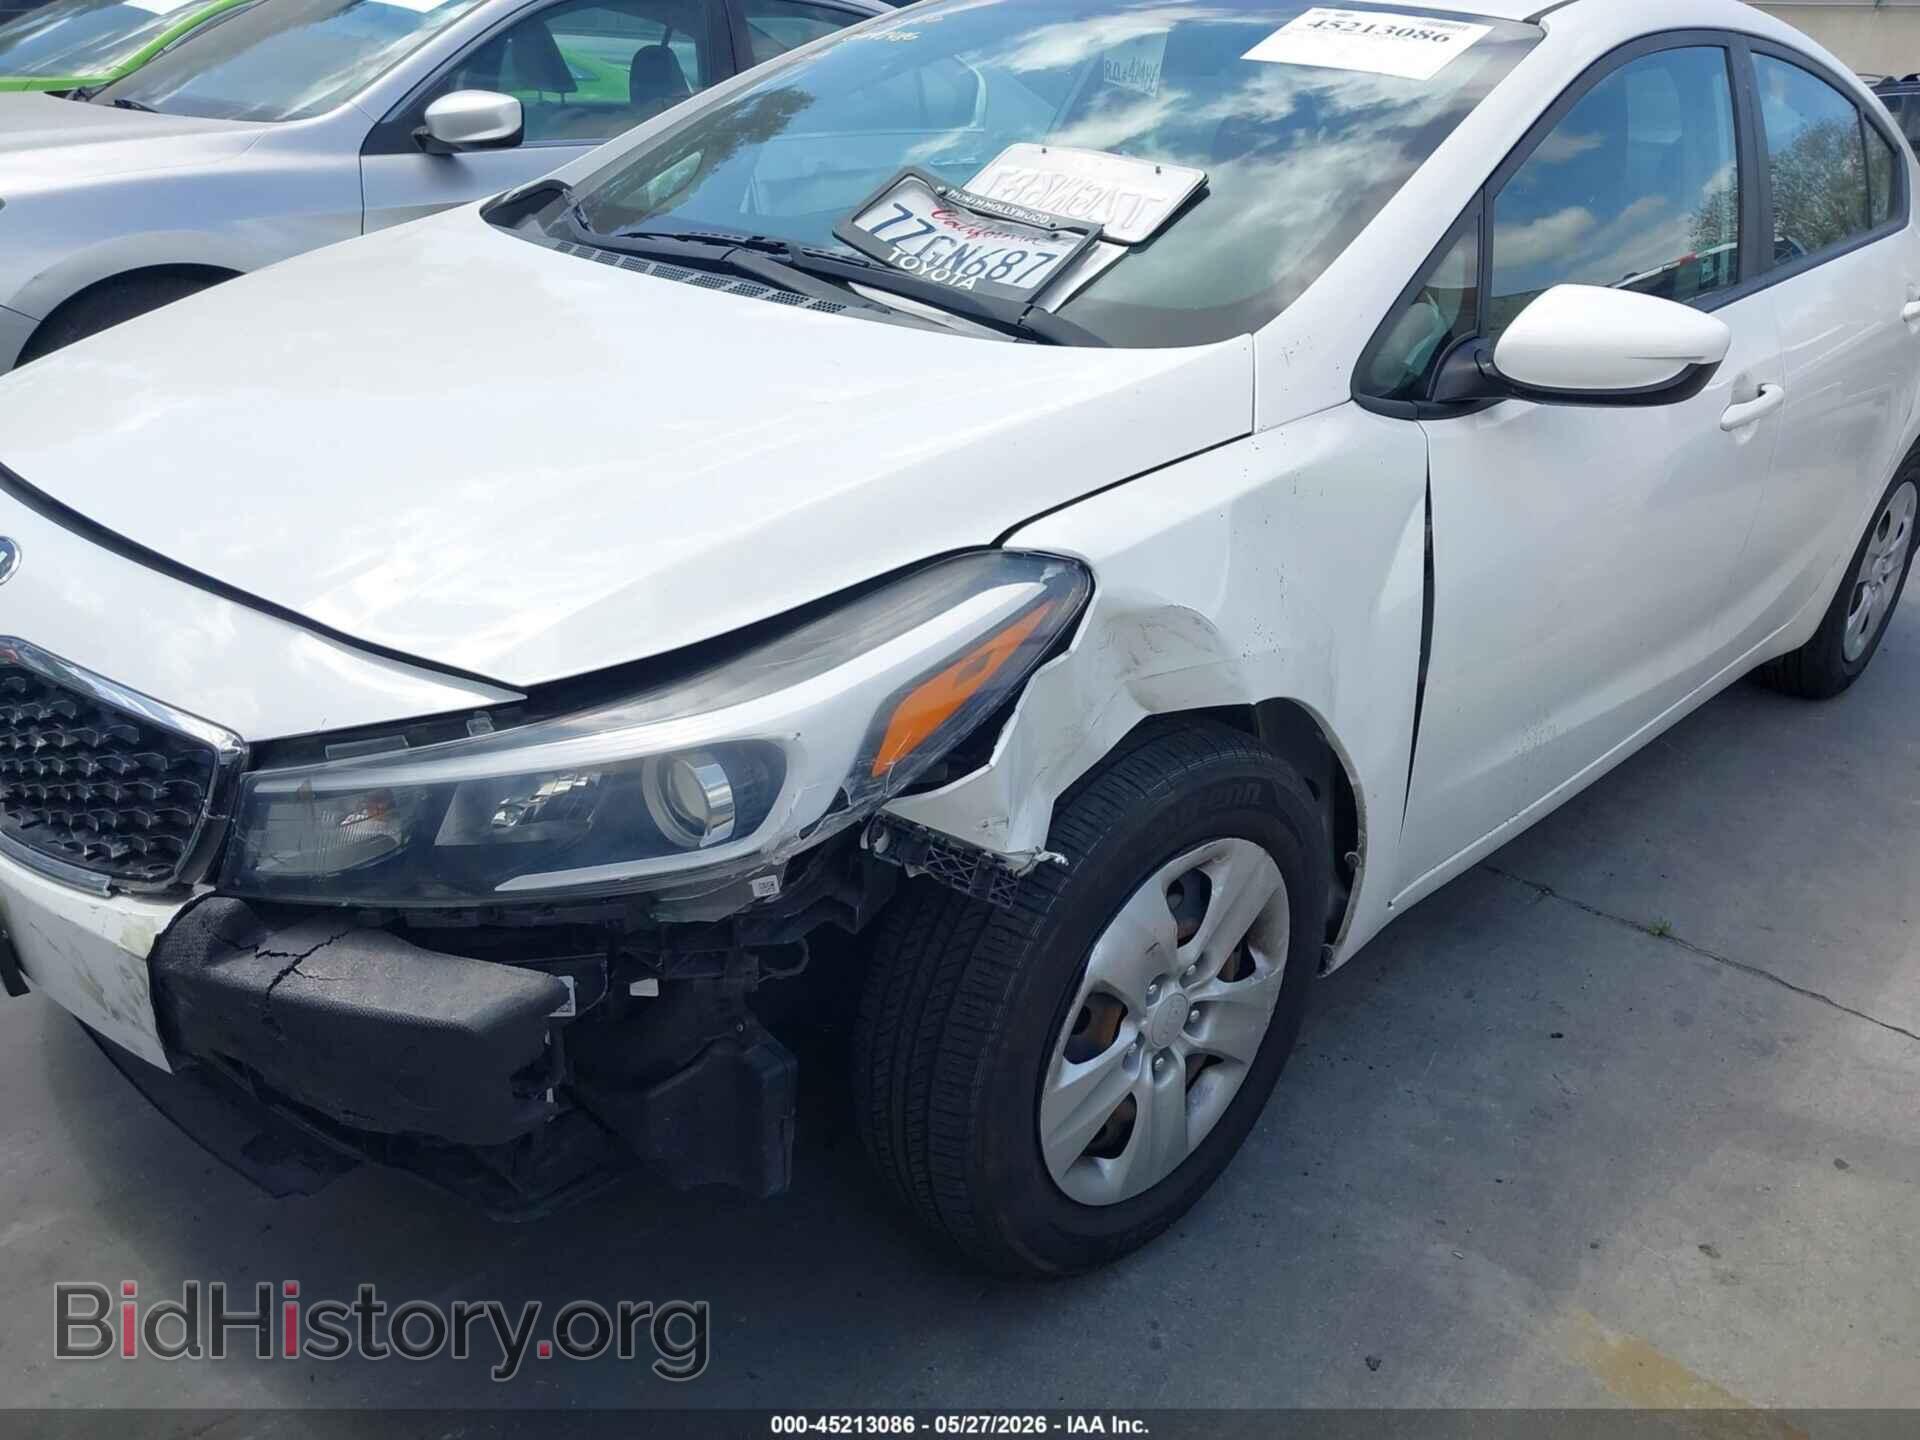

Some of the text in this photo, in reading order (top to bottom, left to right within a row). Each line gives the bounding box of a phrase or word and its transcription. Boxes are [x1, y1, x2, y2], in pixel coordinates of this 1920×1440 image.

[1307, 19, 1450, 43] 45213086
[931, 207, 1041, 244] California
[985, 199, 1051, 224] HOLLYWOOD
[887, 246, 978, 290] TOYOTA
